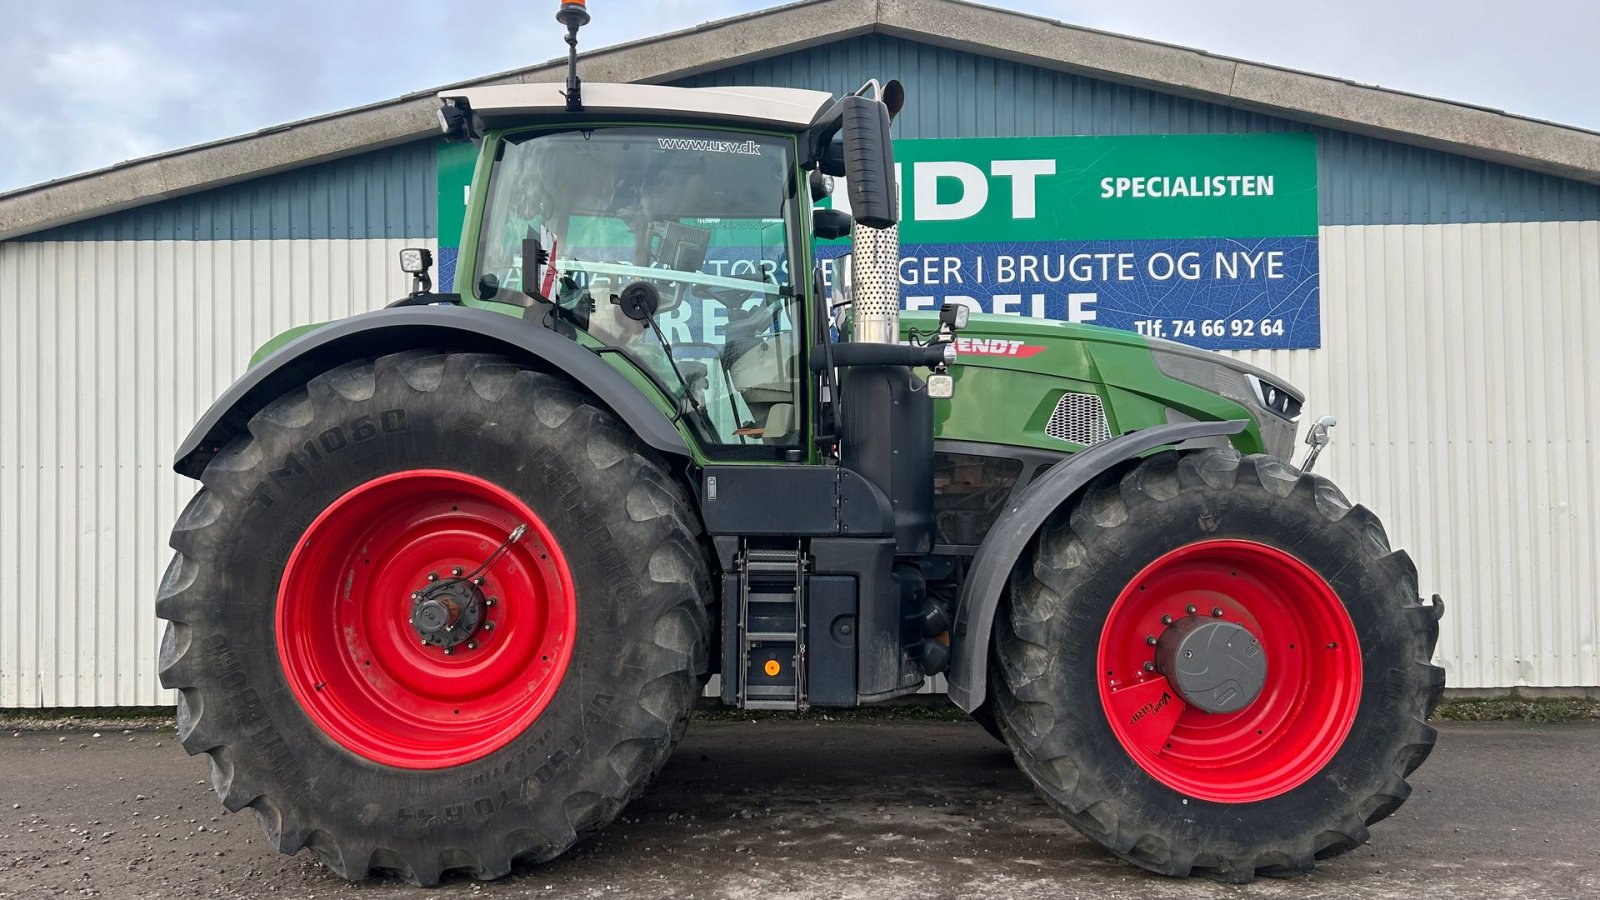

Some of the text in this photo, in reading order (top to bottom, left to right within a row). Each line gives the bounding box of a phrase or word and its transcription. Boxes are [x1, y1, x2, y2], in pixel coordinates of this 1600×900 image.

[658, 138, 761, 156] www.usv.dk
[1100, 175, 1275, 199] SPECIALISTEN
[977, 256, 982, 282] I
[996, 252, 1134, 283] BRUGTE
[1147, 251, 1200, 280] OG
[1215, 250, 1284, 280] NYE
[1134, 319, 1284, 337] Tlf. 74 66 92 64
[954, 337, 1025, 355] ENDT
[244, 404, 410, 512] TM1060
[1130, 703, 1155, 726] GRIP
